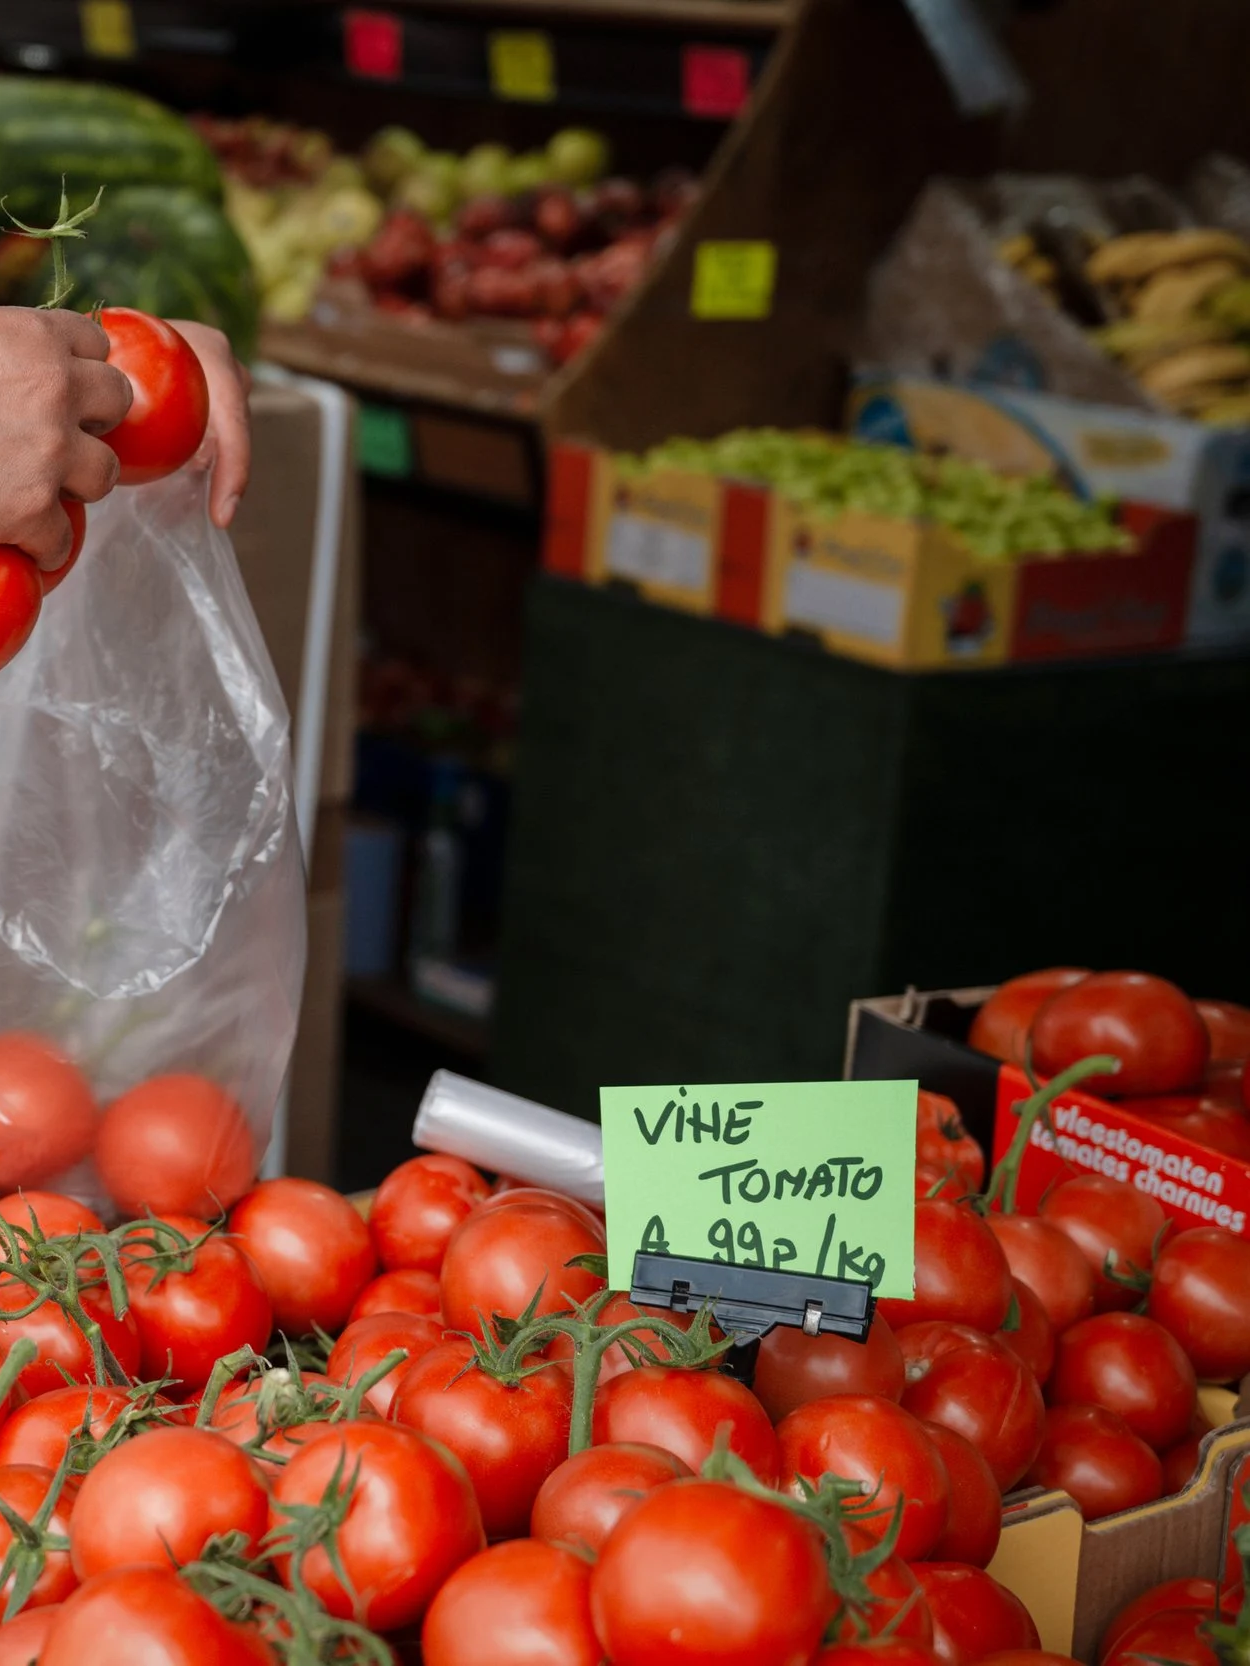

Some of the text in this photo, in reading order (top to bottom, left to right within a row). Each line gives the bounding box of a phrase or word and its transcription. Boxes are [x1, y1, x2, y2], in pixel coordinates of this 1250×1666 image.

[698, 1156, 883, 1205] TOMATO
[1030, 1120, 1247, 1233] tomates charnues
[1054, 1105, 1225, 1197] vleestomaten
